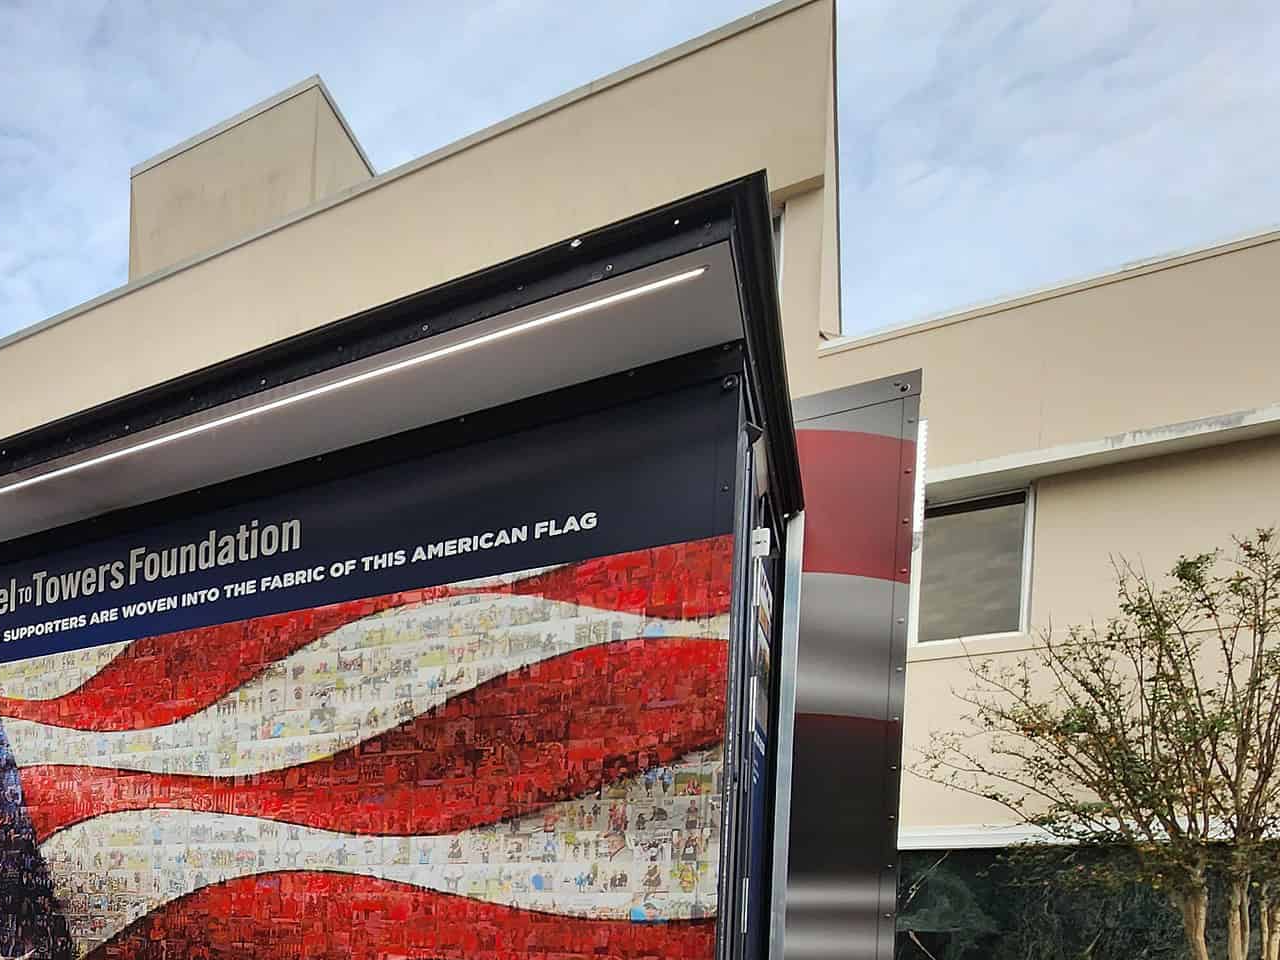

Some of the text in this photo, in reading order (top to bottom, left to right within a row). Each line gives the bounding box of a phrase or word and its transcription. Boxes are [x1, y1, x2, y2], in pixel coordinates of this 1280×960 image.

[3, 614, 88, 643] SUPPORTERS
[89, 608, 119, 626] ARE
[122, 595, 178, 619] WOVEN
[181, 587, 220, 607] INTO
[223, 580, 257, 598] THE
[260, 565, 325, 592] FABRIC
[330, 559, 357, 578] OF
[361, 550, 406, 573] THIS
[411, 525, 528, 563] AMERICAN
[534, 511, 598, 540] FLAG
[33, 560, 125, 607] Towers
[128, 519, 302, 586] Foundation
